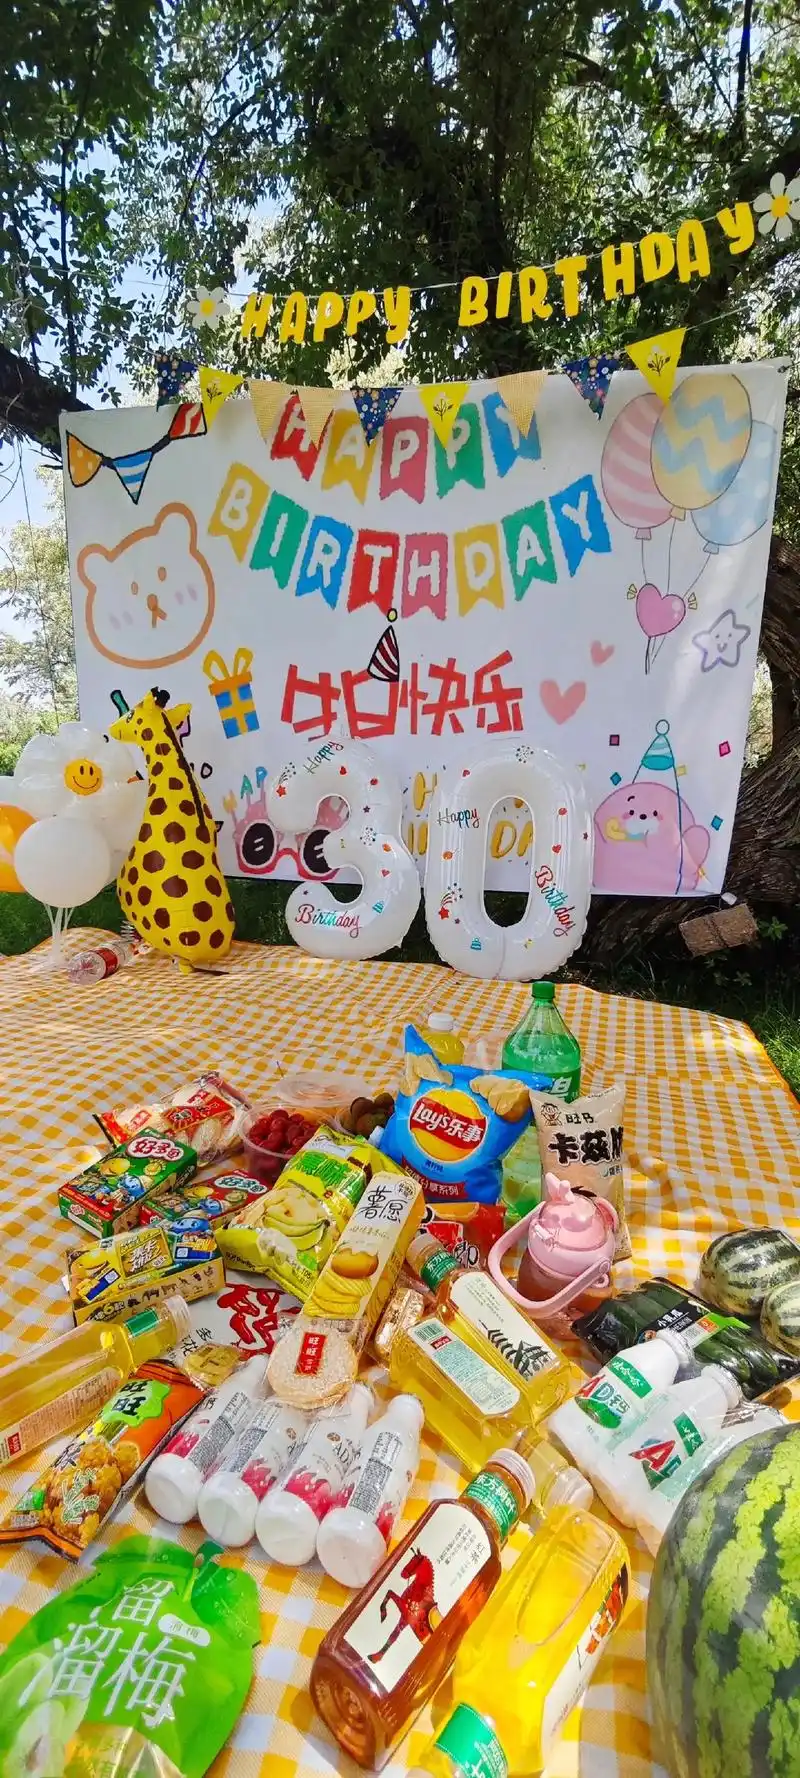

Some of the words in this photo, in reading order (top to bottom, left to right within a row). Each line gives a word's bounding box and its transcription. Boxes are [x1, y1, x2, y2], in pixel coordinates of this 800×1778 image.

[240, 286, 412, 345] HAPPY
[458, 201, 756, 328] BIRTHDAY
[219, 488, 598, 598] BIRTHDAY
[303, 741, 344, 774] Happy
[437, 808, 479, 829] Happy
[295, 903, 362, 938] Birthday
[534, 865, 576, 937] Birthday
